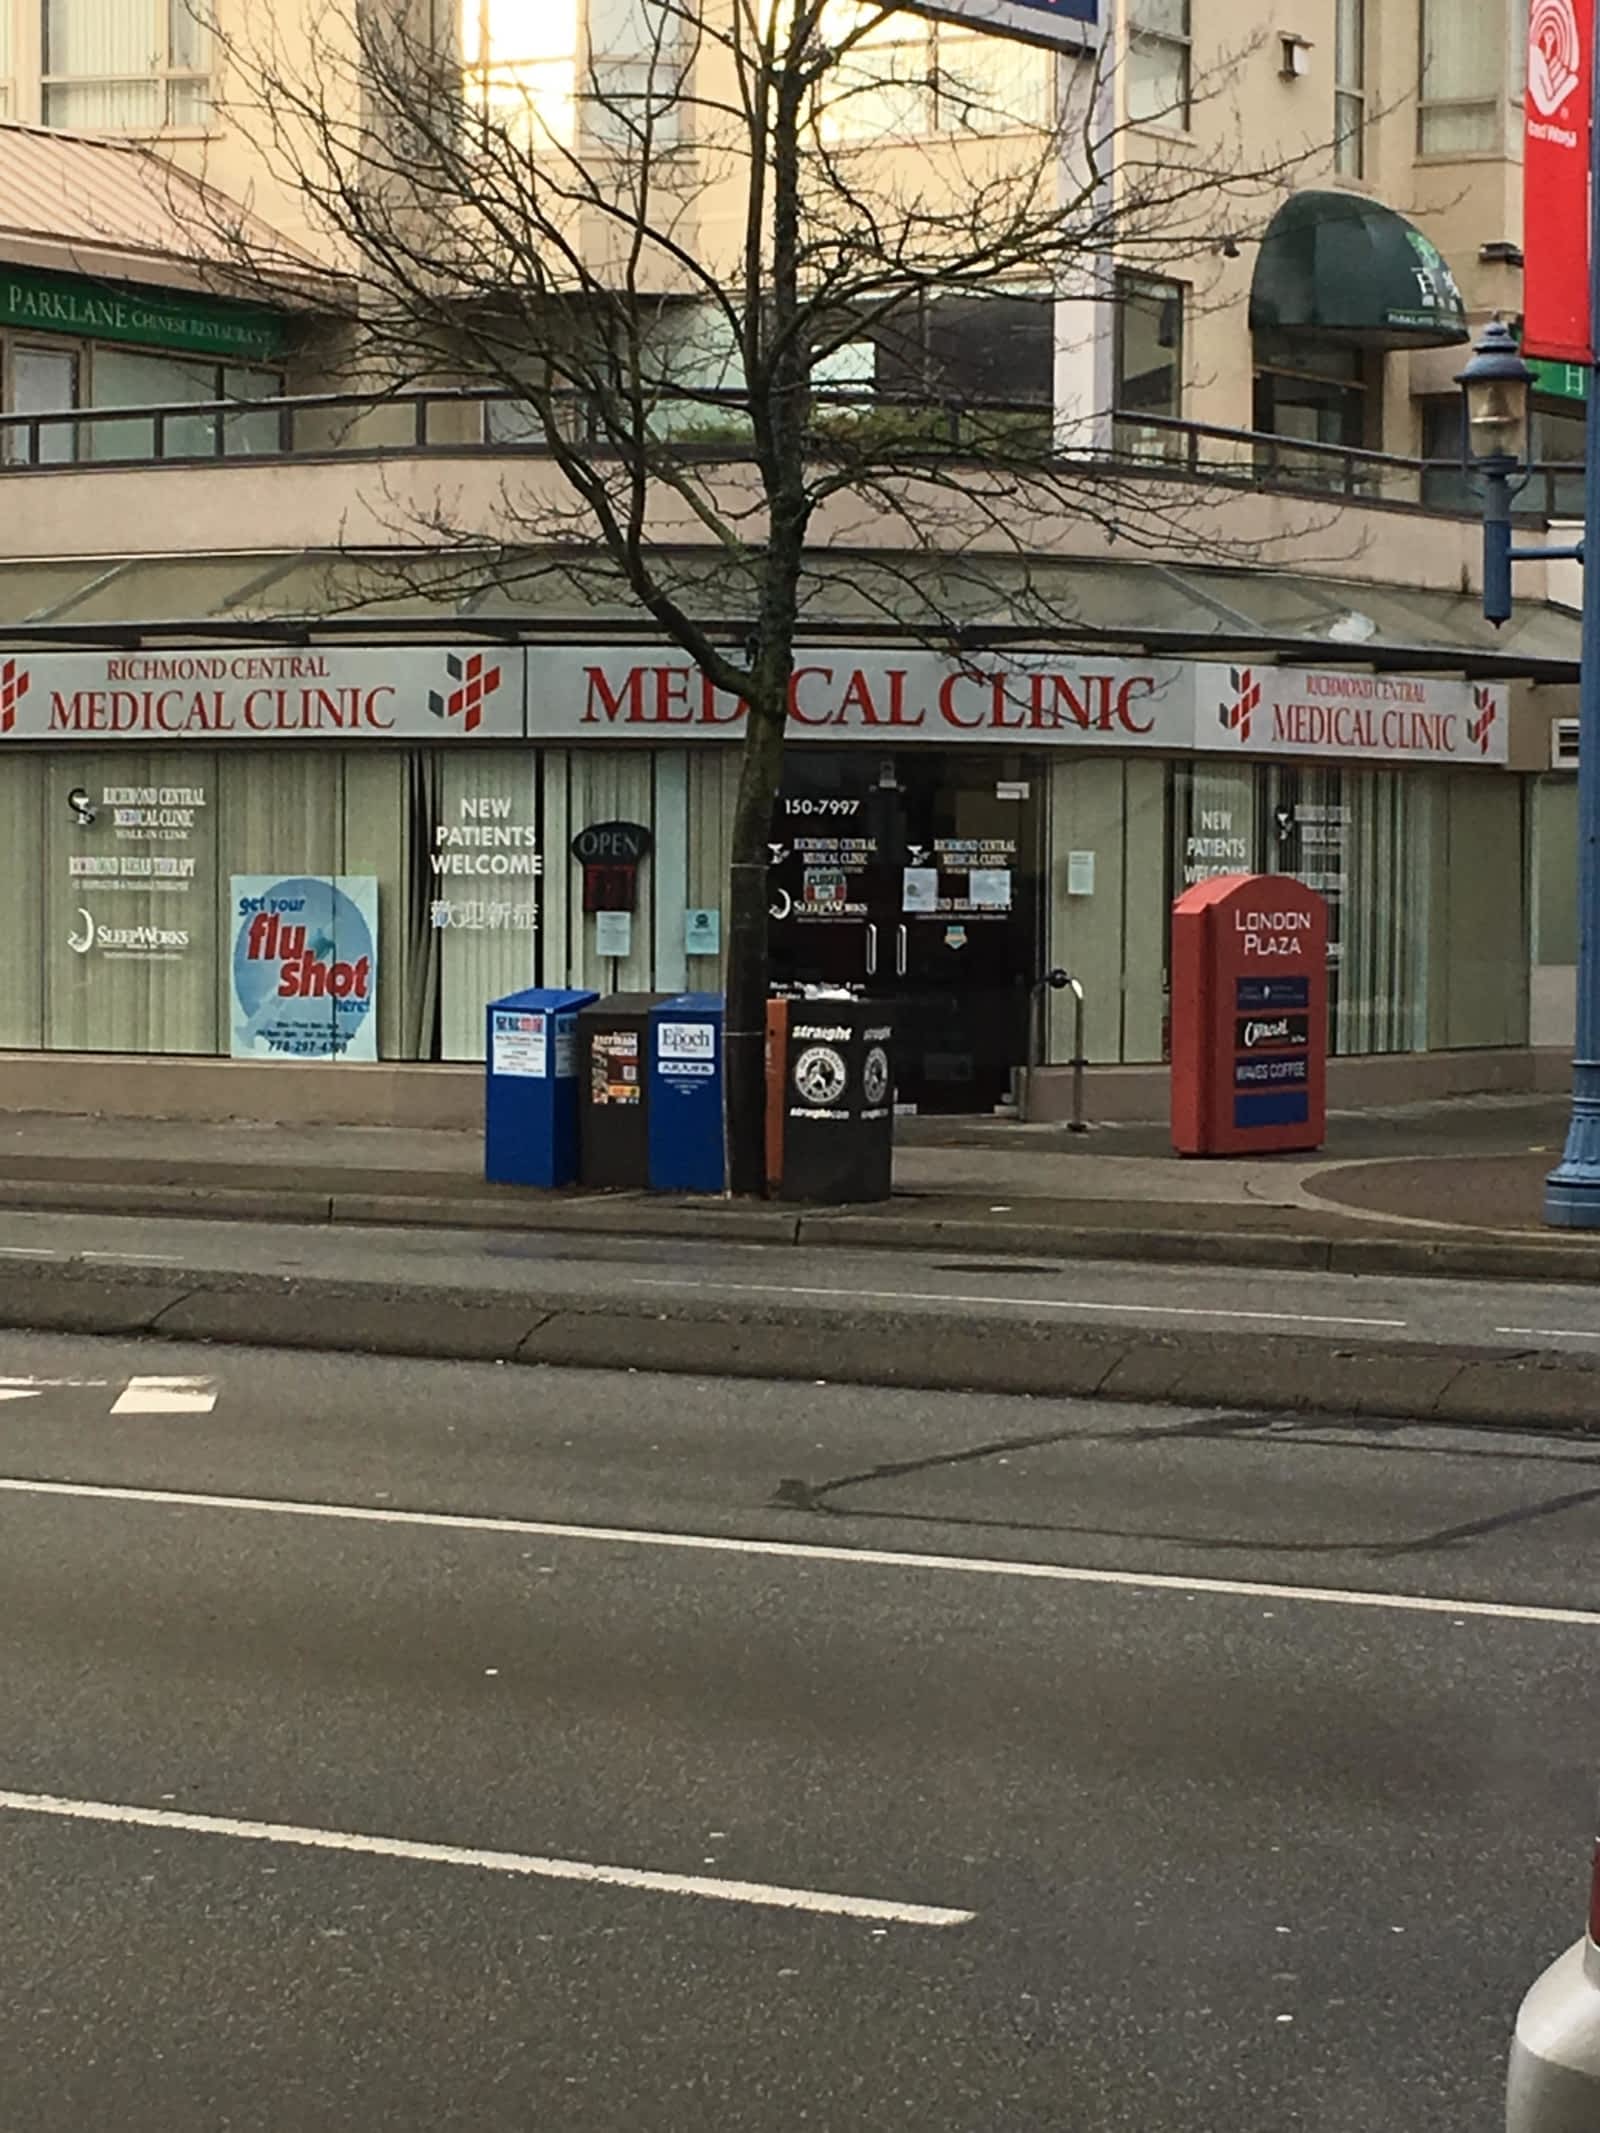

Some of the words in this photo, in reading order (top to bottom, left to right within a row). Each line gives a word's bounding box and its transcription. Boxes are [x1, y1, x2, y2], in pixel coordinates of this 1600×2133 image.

[8, 284, 129, 329] PARKLANE
[131, 310, 188, 333] CHINESE
[106, 658, 226, 681] RICHMOND
[231, 656, 330, 680] CENTRAL
[579, 666, 926, 726] MEDCAL
[938, 670, 1155, 734] CLINIC
[1306, 675, 1372, 699] RICHMOND
[1374, 680, 1426, 704] CENTRAL
[48, 690, 235, 731] MEDICAL
[243, 686, 396, 730] CLINIC
[1272, 703, 1377, 746] MEDICAL
[1381, 709, 1457, 752] CLINIC
[461, 798, 511, 818] NEW
[785, 799, 860, 816] 150-7997
[1201, 810, 1232, 830] NEW
[436, 826, 536, 847] PATIENTS
[580, 832, 639, 855] OPEN
[1187, 838, 1246, 858] PATIENTS
[430, 854, 543, 875] WELCOME
[239, 897, 265, 916] get
[270, 898, 305, 913] your
[1235, 909, 1311, 931] LONDON
[247, 913, 306, 960] flu
[1244, 934, 1301, 955] PLAZA
[278, 950, 369, 998] shot
[662, 1028, 710, 1051] Epoch
[792, 1025, 852, 1042] straight
[1270, 1061, 1305, 1078] COFFEE
